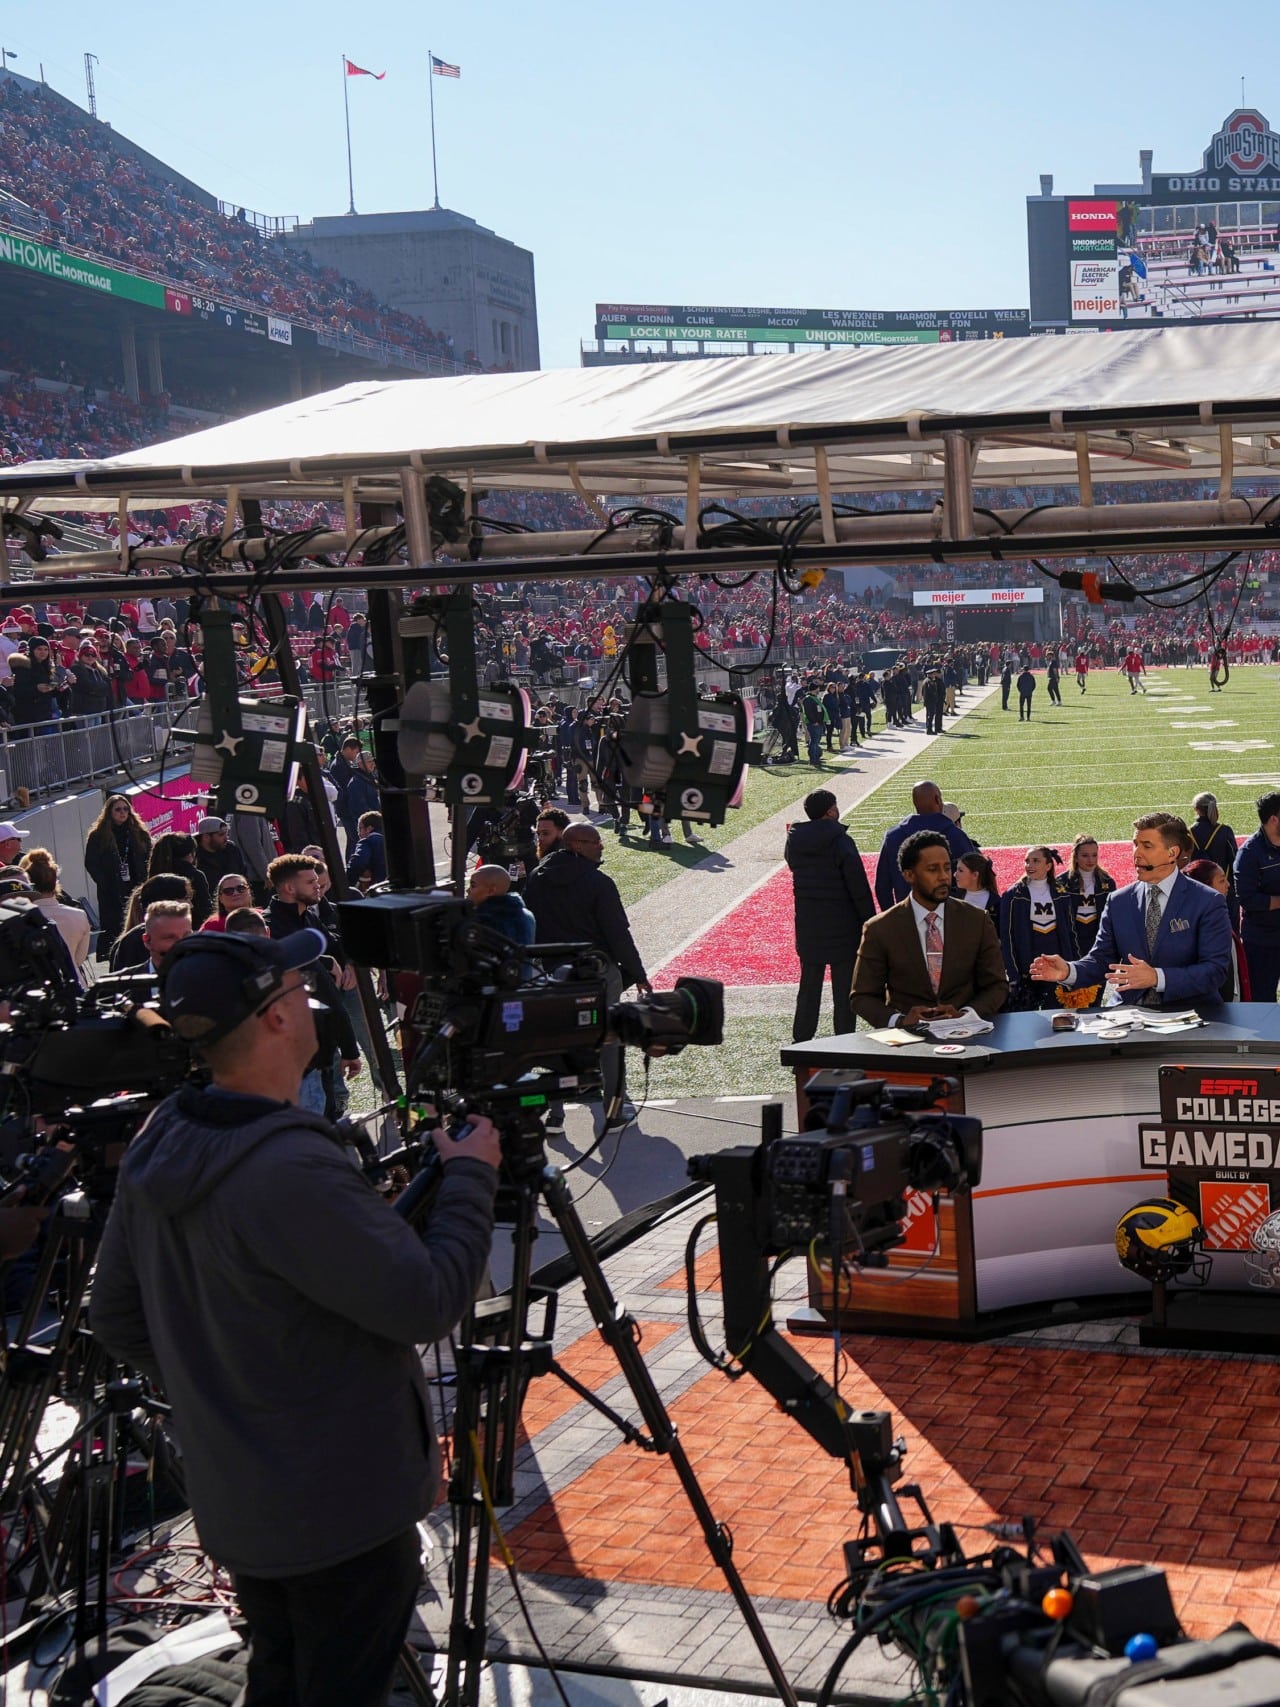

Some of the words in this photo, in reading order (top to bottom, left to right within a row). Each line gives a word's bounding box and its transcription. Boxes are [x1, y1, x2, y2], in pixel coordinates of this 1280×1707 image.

[1216, 132, 1242, 168] OHIO
[1242, 128, 1279, 168] STATE
[1168, 178, 1220, 192] OHIO
[61, 265, 112, 291] MORTGAGE
[174, 299, 182, 312] 0
[192, 296, 215, 313] 58:20
[1073, 296, 1118, 314] meijer
[774, 308, 807, 316] DIAMOND
[822, 311, 840, 319] LES
[842, 312, 885, 321] WEXNER
[895, 312, 937, 321] HARMON
[949, 311, 988, 319] COVELLI
[994, 311, 1027, 319] WELLS
[225, 314, 233, 327] 0
[600, 314, 627, 323] AUER
[637, 315, 674, 324] CRONIN
[686, 316, 715, 325] CLINE
[767, 318, 800, 327] McCOY
[831, 319, 878, 328] WANDELL
[915, 320, 949, 328] WOLFE
[952, 319, 971, 328] FDN
[270, 326, 290, 342] KPMG
[630, 327, 661, 337] LOCK
[665, 328, 677, 337] IN
[680, 328, 711, 338] YOUR
[716, 329, 748, 339] RATE!
[931, 591, 966, 604] meijer
[991, 589, 1025, 602] meijer
[1033, 902, 1054, 916] M
[1200, 1079, 1259, 1096] ESPN
[1215, 1171, 1238, 1180] BUILT
[1239, 1172, 1250, 1180] BY
[1205, 1184, 1268, 1249] HOME
